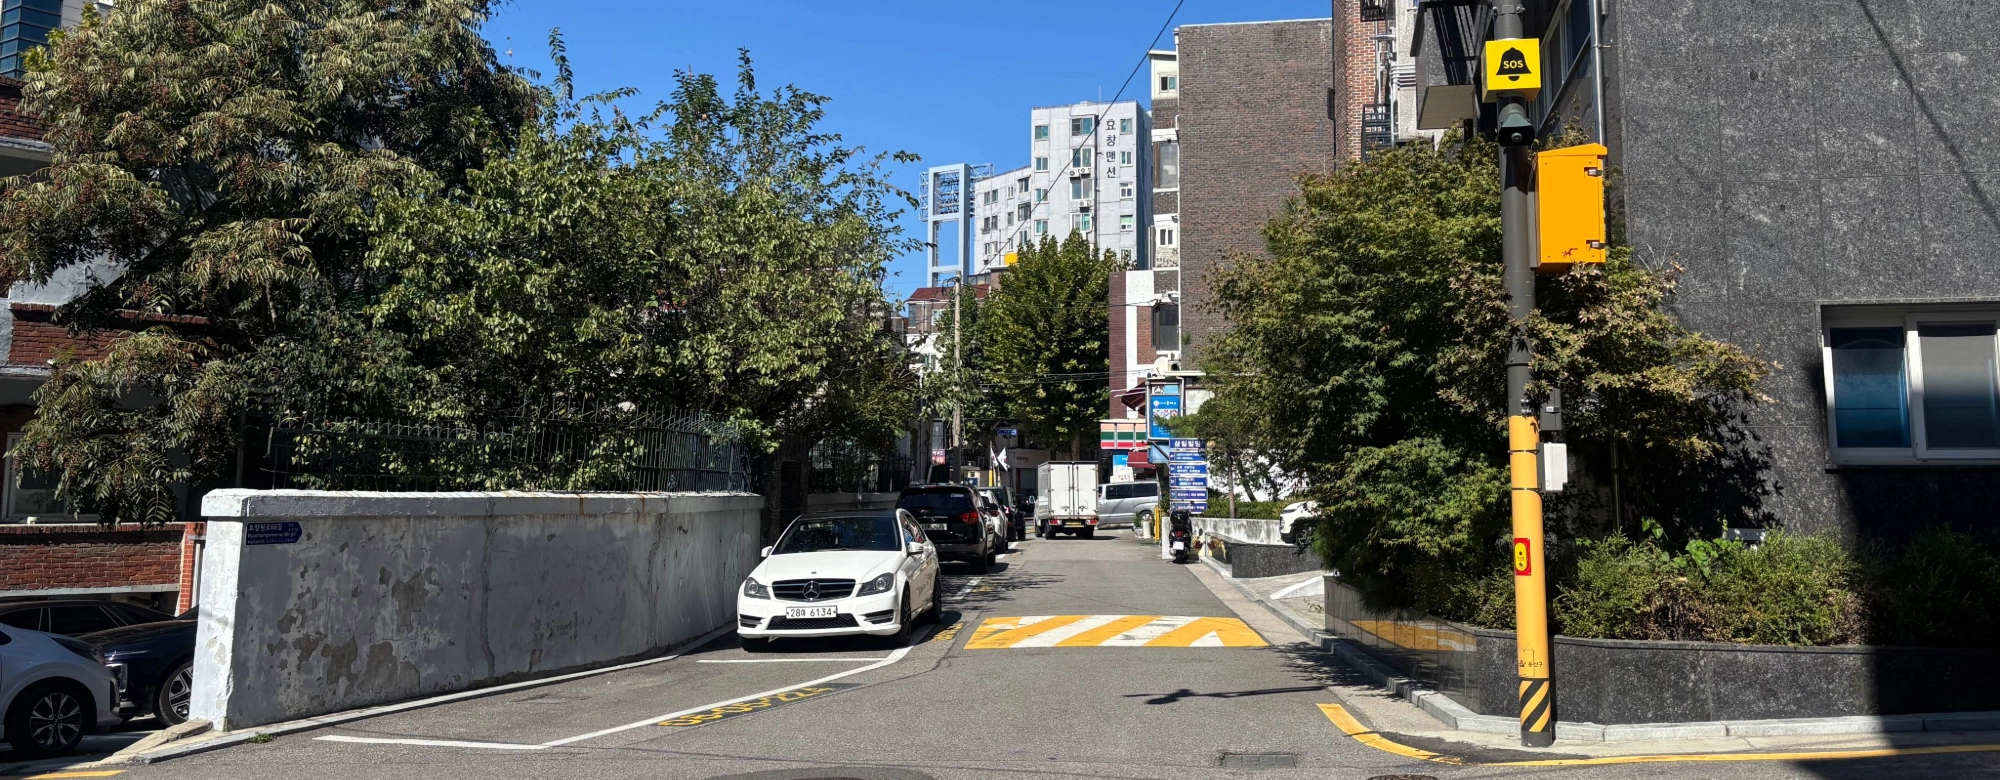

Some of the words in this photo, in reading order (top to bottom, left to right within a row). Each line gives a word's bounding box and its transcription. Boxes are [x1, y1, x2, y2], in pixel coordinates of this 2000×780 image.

[1503, 60, 1524, 69] SOS
[1105, 119, 1116, 178] 효창맨션
[249, 523, 282, 531] 효창원로66길
[810, 608, 832, 616] 6134
